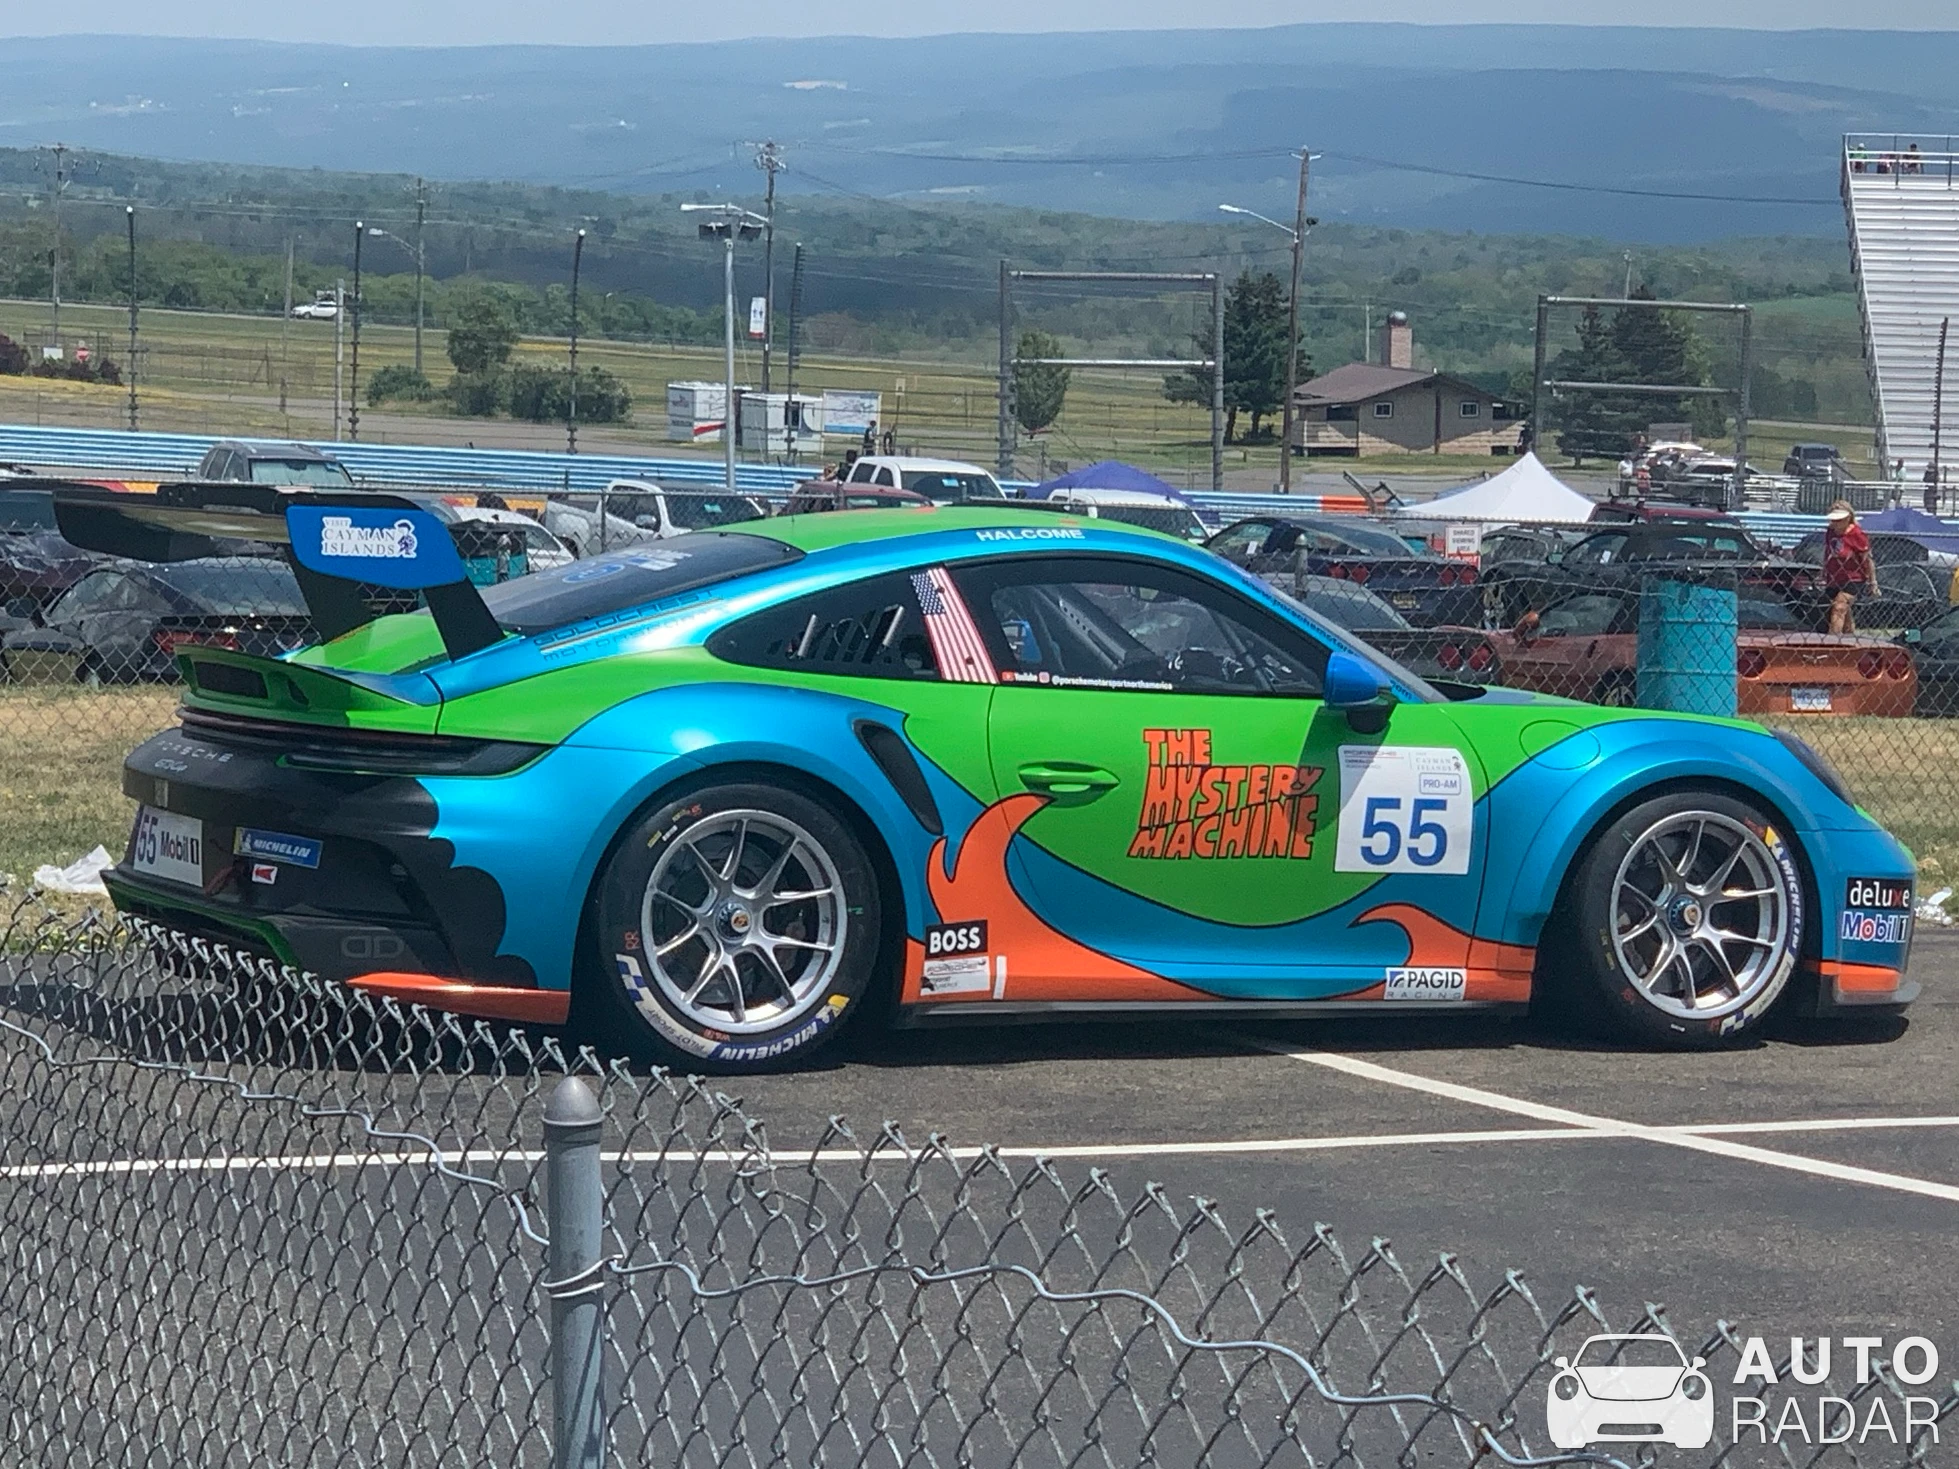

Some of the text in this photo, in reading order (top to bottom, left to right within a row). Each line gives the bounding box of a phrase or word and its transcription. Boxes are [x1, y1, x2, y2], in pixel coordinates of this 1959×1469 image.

[323, 542, 395, 556] ISLANDS
[324, 528, 396, 542] CAYMAN
[975, 528, 1086, 542] HALCOME
[533, 588, 714, 646] GOLDCREST
[1143, 728, 1213, 766] THE
[1138, 764, 1326, 830] MYSTERY
[1422, 779, 1458, 789] PRO-AM
[137, 813, 159, 865] 55
[160, 830, 189, 863] Mobil
[1126, 795, 1320, 860] MACHINE
[1359, 796, 1448, 867] 55
[252, 838, 312, 859] MICHELIN
[1780, 858, 1801, 950] MICHELIN
[1849, 880, 1911, 908] deluxe
[929, 926, 981, 954] BOSS
[1841, 910, 1899, 943] Mobil
[1407, 970, 1464, 989] PAGID
[1386, 991, 1462, 999] RACING
[719, 1020, 819, 1061] MICHELIN
